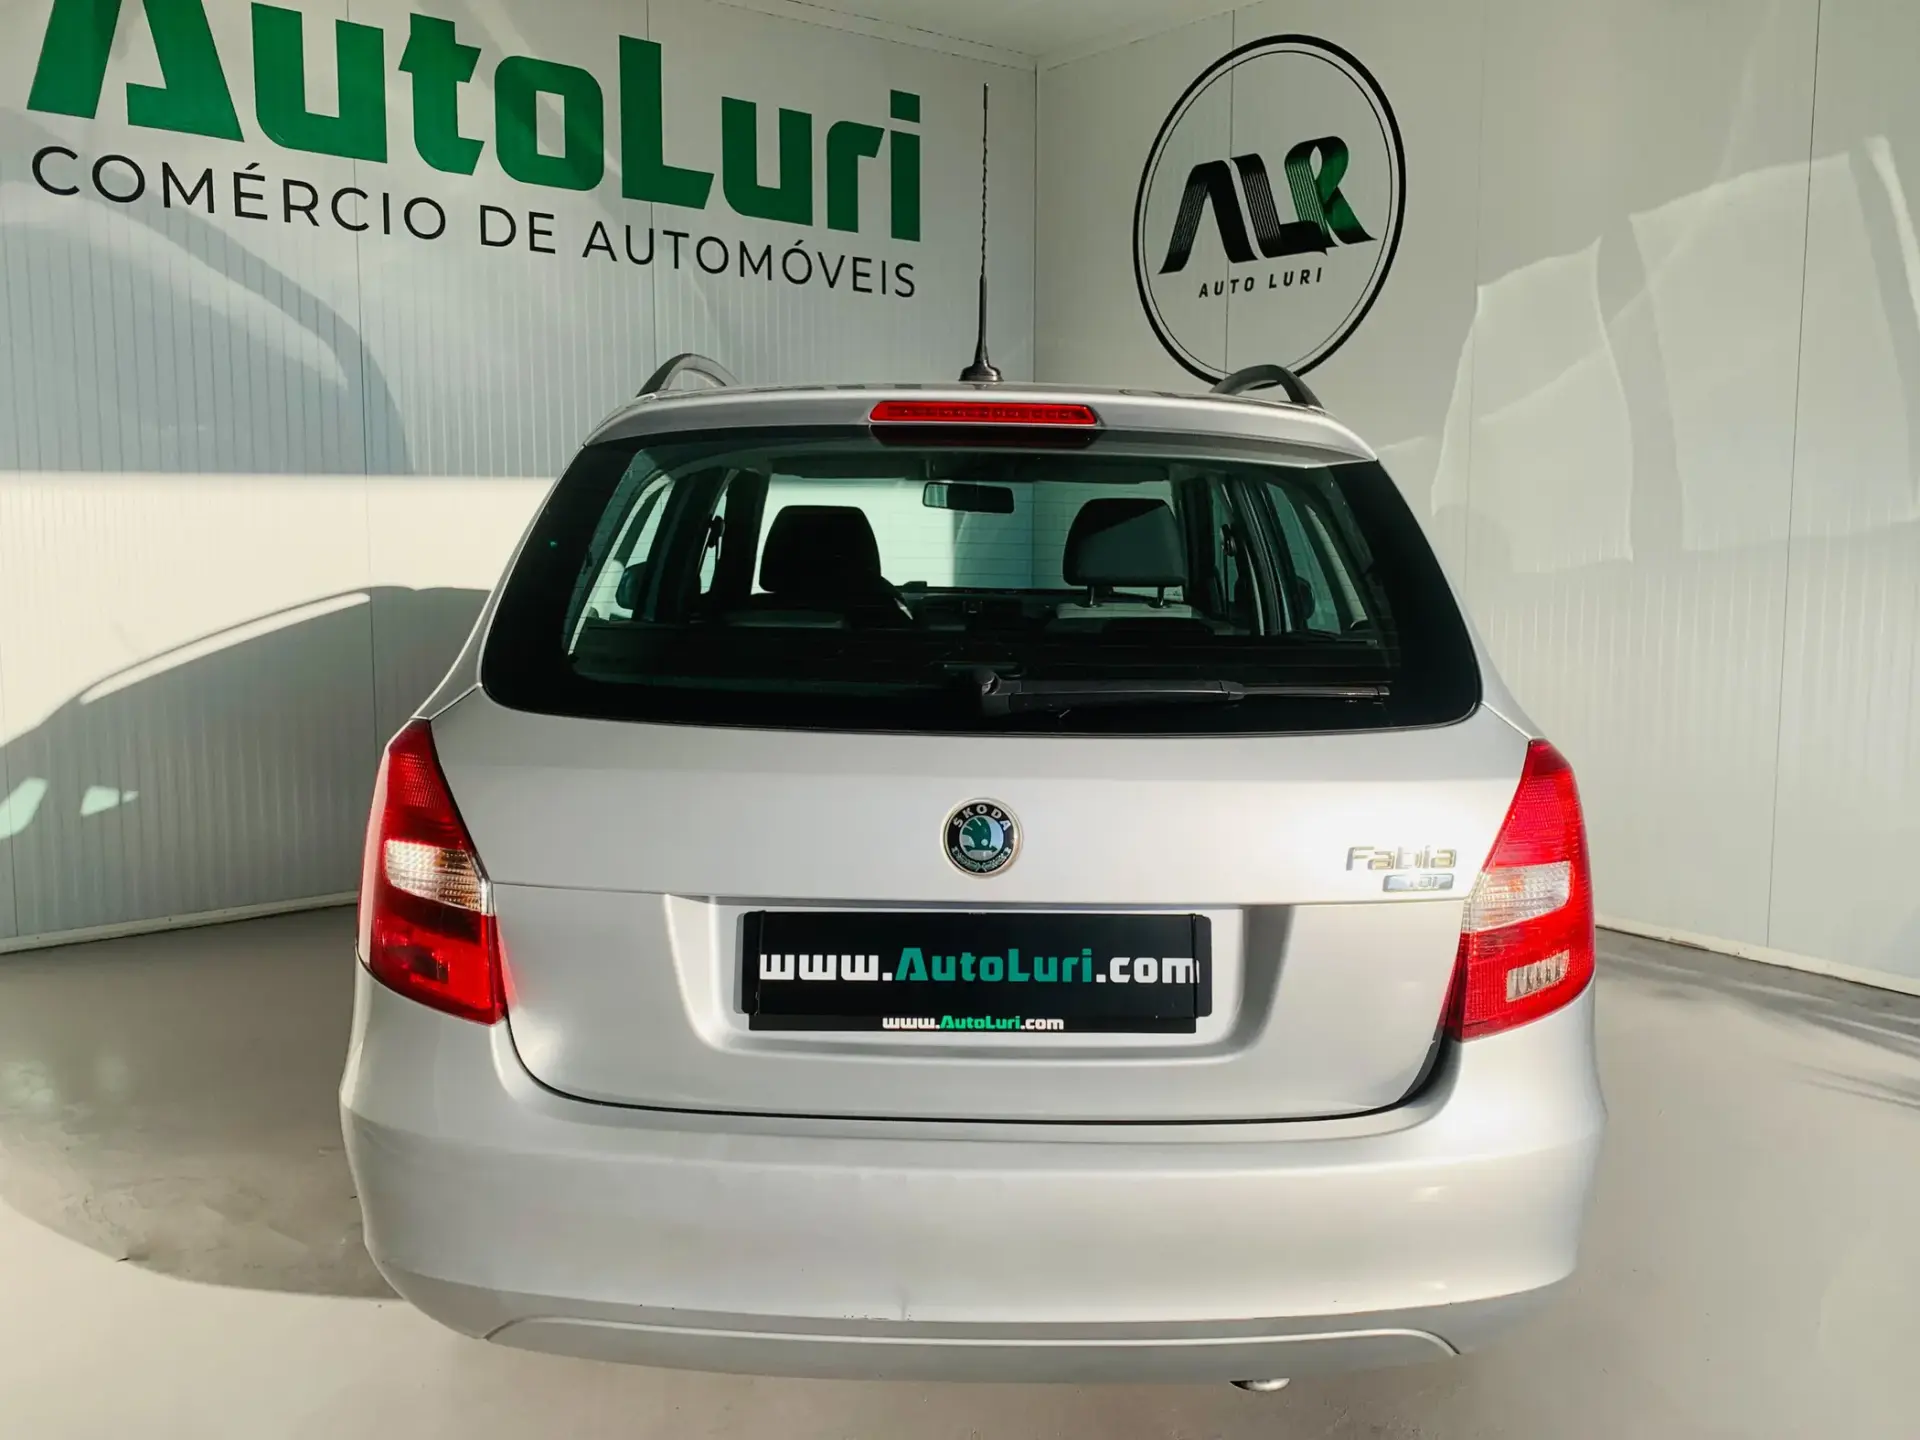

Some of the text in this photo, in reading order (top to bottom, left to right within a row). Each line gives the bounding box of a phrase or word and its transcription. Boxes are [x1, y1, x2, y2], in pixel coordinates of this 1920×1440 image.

[27, 0, 921, 242] AutoLuri
[32, 146, 915, 298] COMÉRCIO DE AUTOMÓVEIS
[1199, 267, 1322, 298] AUTO LURI
[759, 947, 1200, 984] www.AutoLuri.com
[882, 1015, 1065, 1031] www.AutoLuri.com
